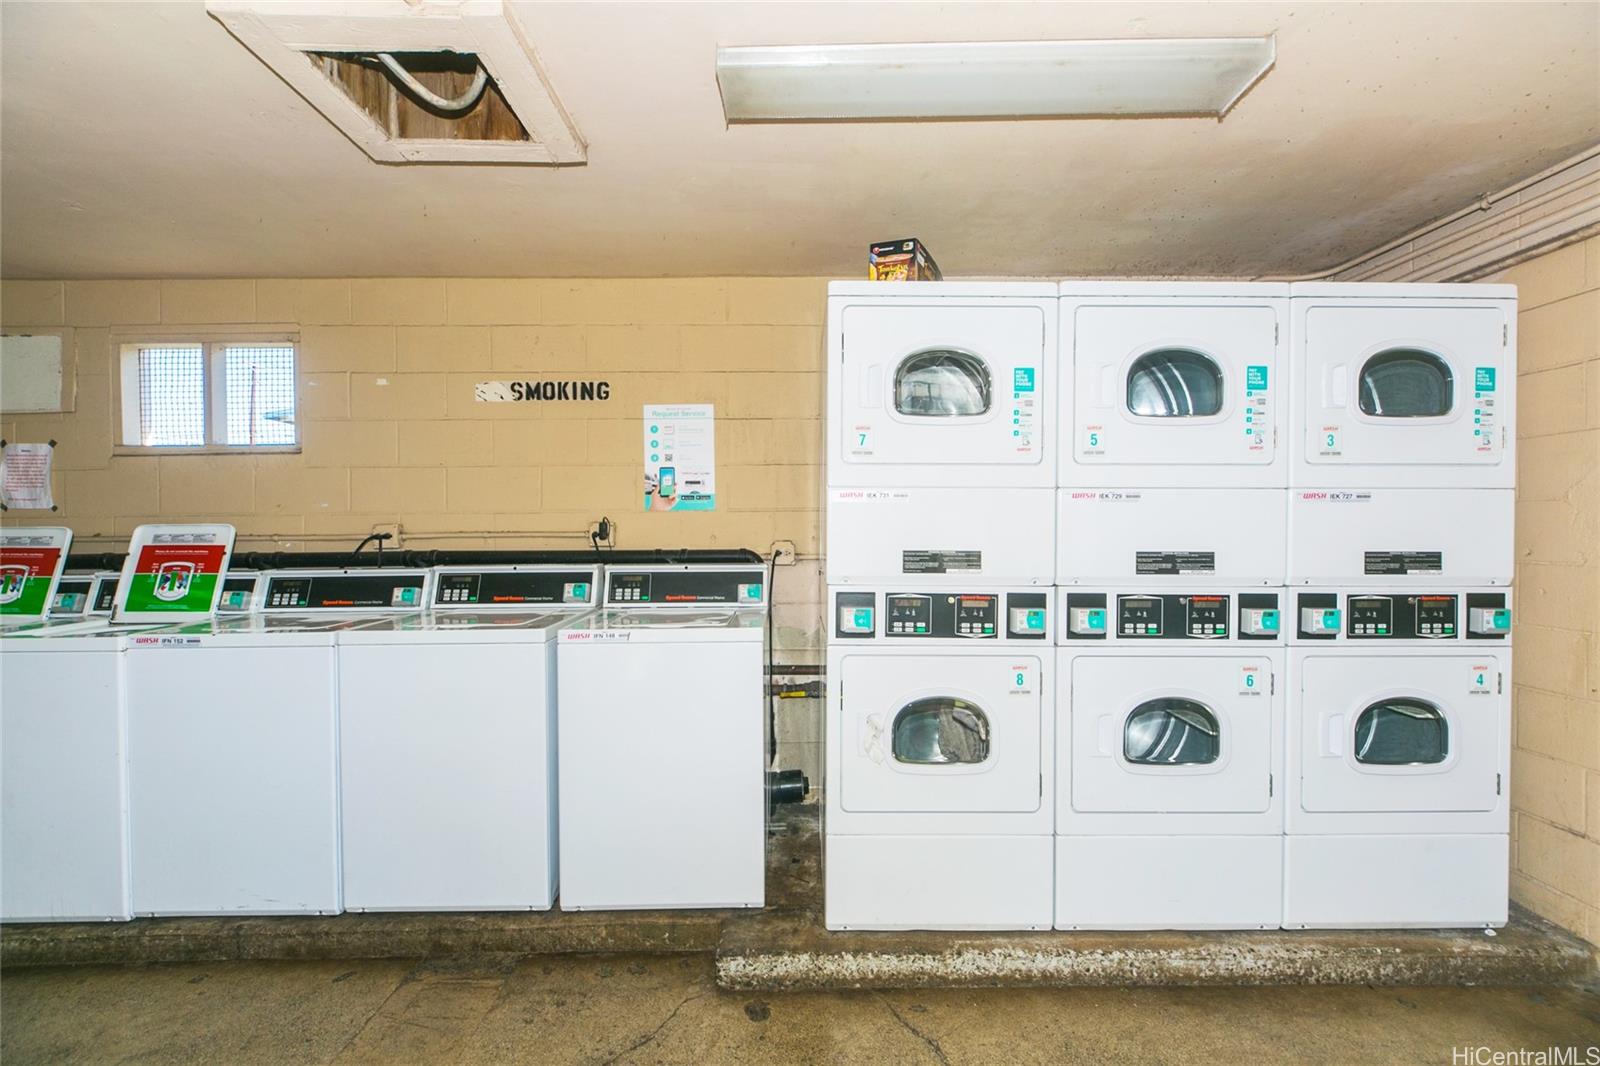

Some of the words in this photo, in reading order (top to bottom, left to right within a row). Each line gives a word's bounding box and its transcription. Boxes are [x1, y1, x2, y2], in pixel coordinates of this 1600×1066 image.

[510, 381, 610, 401] SMOKING
[859, 433, 866, 446] 7
[1090, 433, 1098, 446] 5
[1327, 433, 1334, 447] 3
[1016, 673, 1024, 686] 8
[1246, 674, 1254, 687] 6
[1476, 673, 1484, 686] 4
